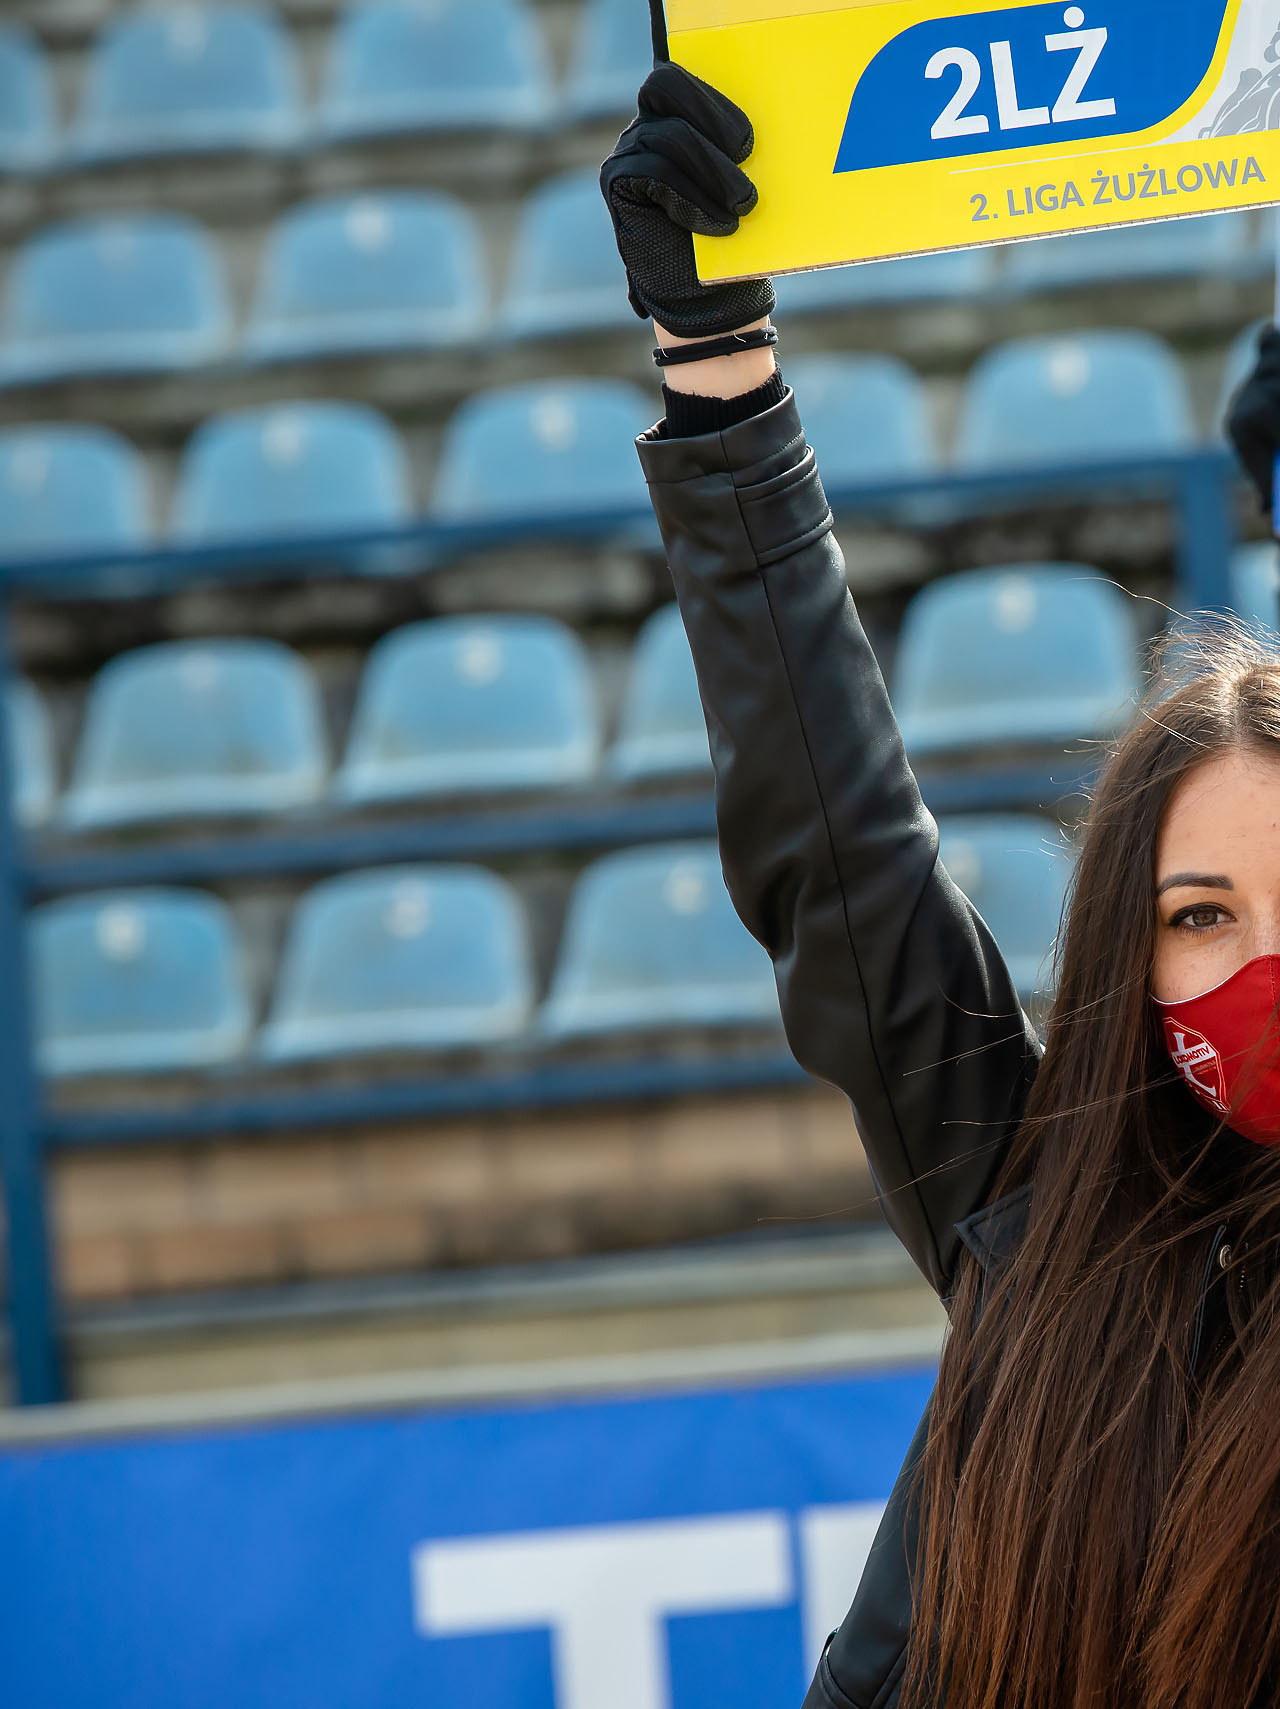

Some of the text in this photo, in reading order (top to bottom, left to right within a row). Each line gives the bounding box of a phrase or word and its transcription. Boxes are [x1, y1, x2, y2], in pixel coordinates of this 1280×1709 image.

[924, 6, 1116, 140] 2LŻ
[969, 156, 1266, 222] 2. LIGA ŻUŻLOWA
